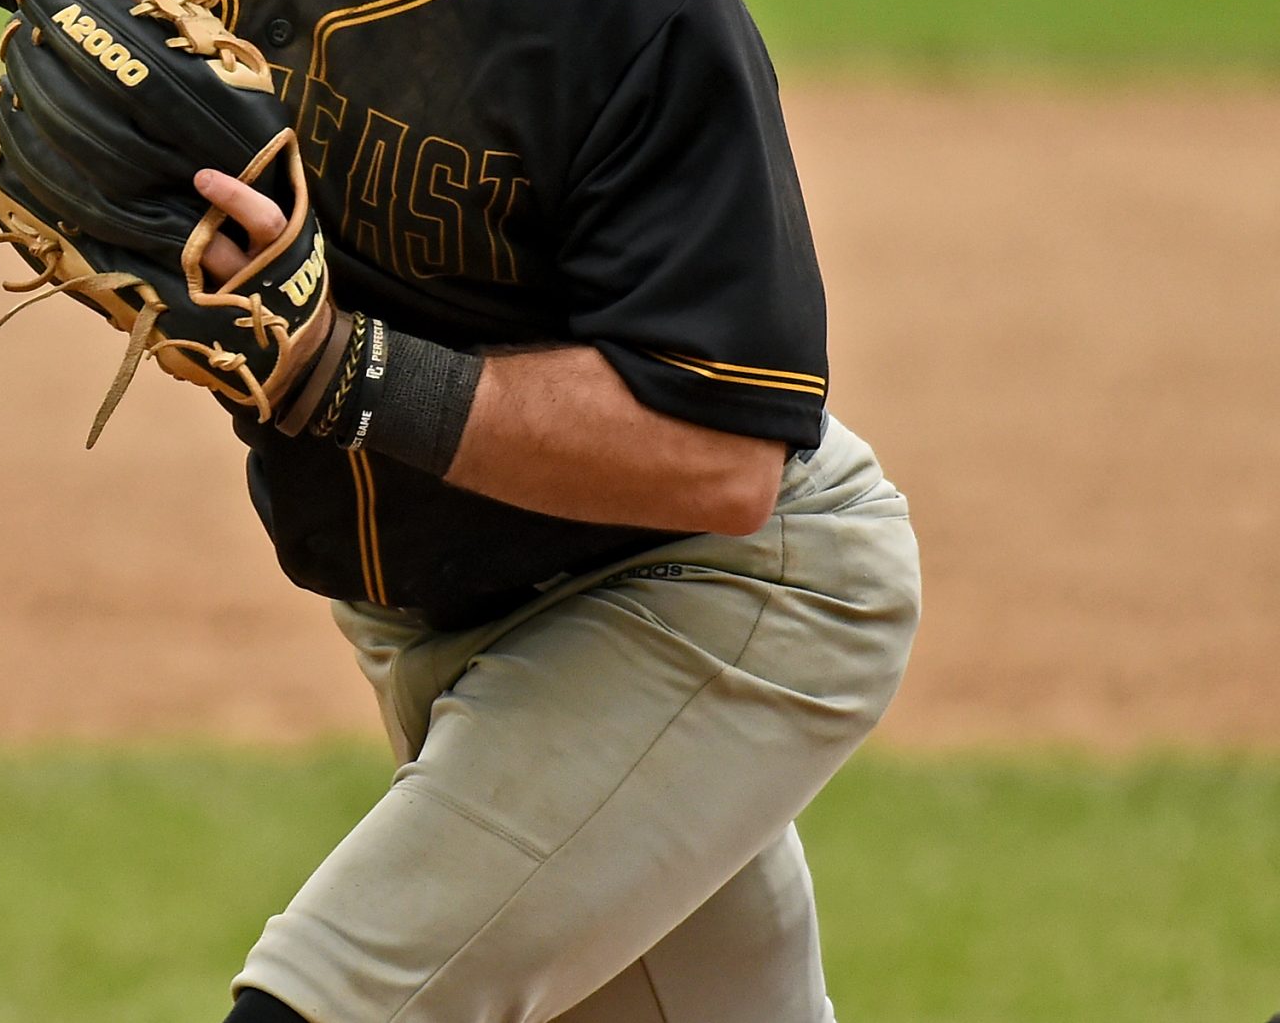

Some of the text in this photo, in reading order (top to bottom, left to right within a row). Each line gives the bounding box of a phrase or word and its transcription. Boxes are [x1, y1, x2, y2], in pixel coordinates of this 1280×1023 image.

[51, 3, 150, 88] A2000
[268, 62, 531, 284] EAST
[356, 409, 373, 437] GAME
